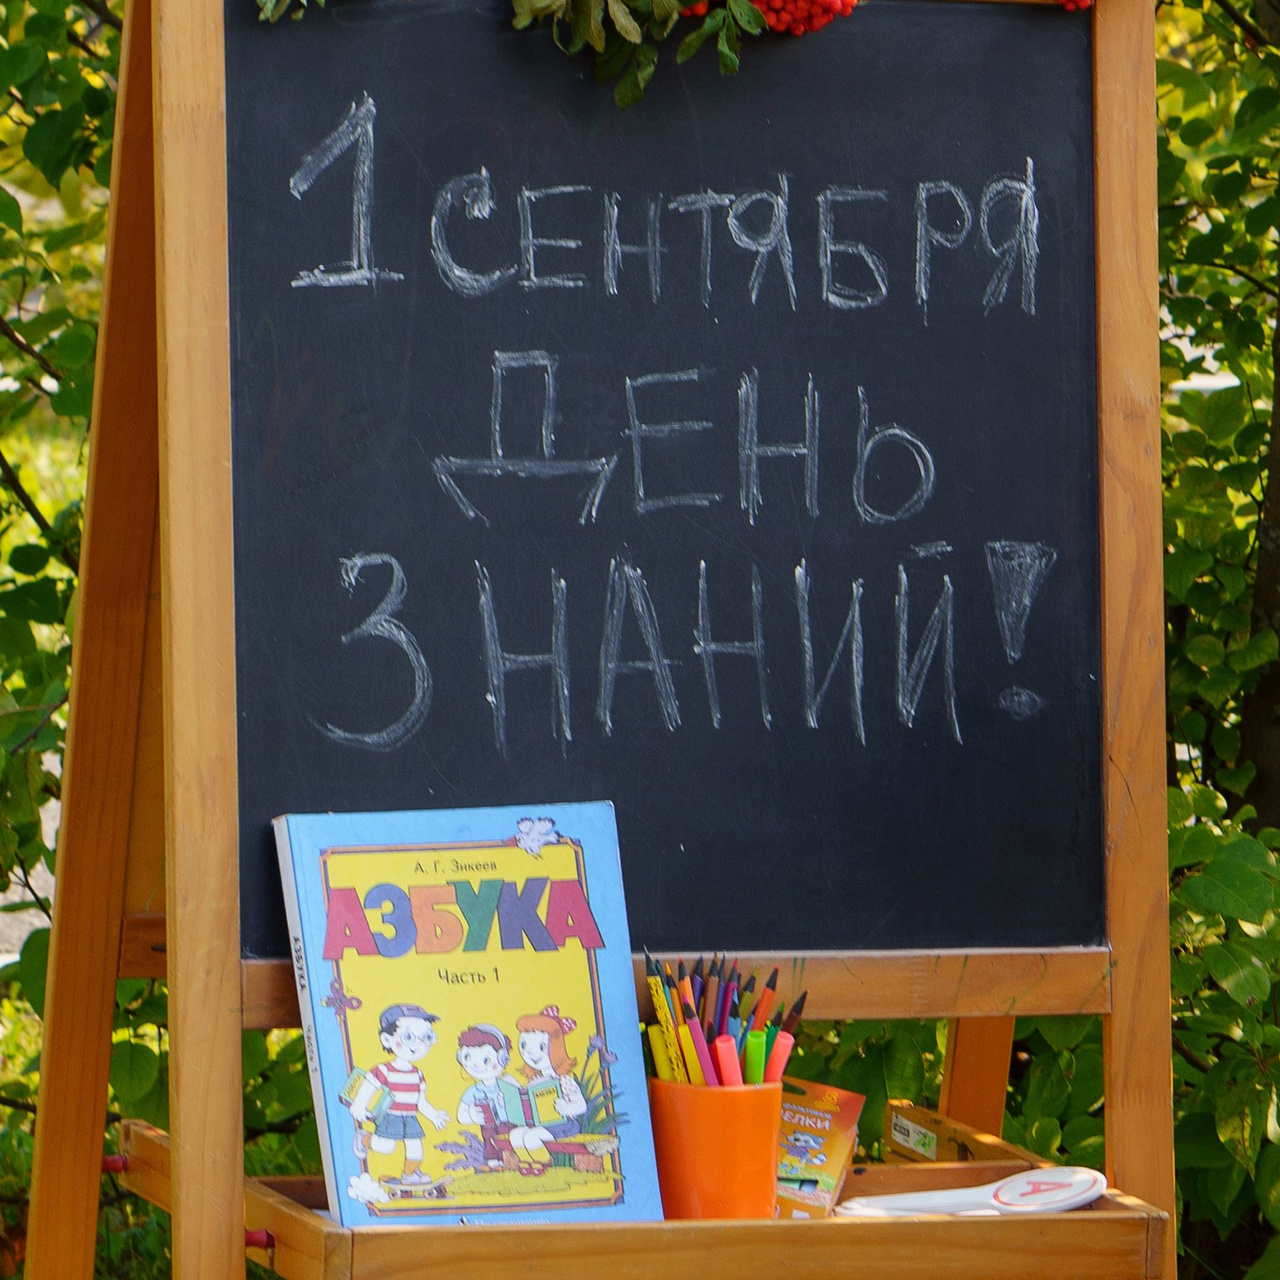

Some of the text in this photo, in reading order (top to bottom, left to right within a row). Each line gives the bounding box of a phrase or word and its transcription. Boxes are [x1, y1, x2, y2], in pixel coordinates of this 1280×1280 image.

[289, 91, 1040, 322] 1 СЕНТЯБРЯ
[431, 349, 936, 525] ДЕНЬ
[311, 541, 1058, 756] ЗНАНИЙ!
[322, 877, 605, 960] АЗБУКА
[414, 858, 498, 875] А. Г. Зикеев
[437, 966, 500, 985] Часть 1
